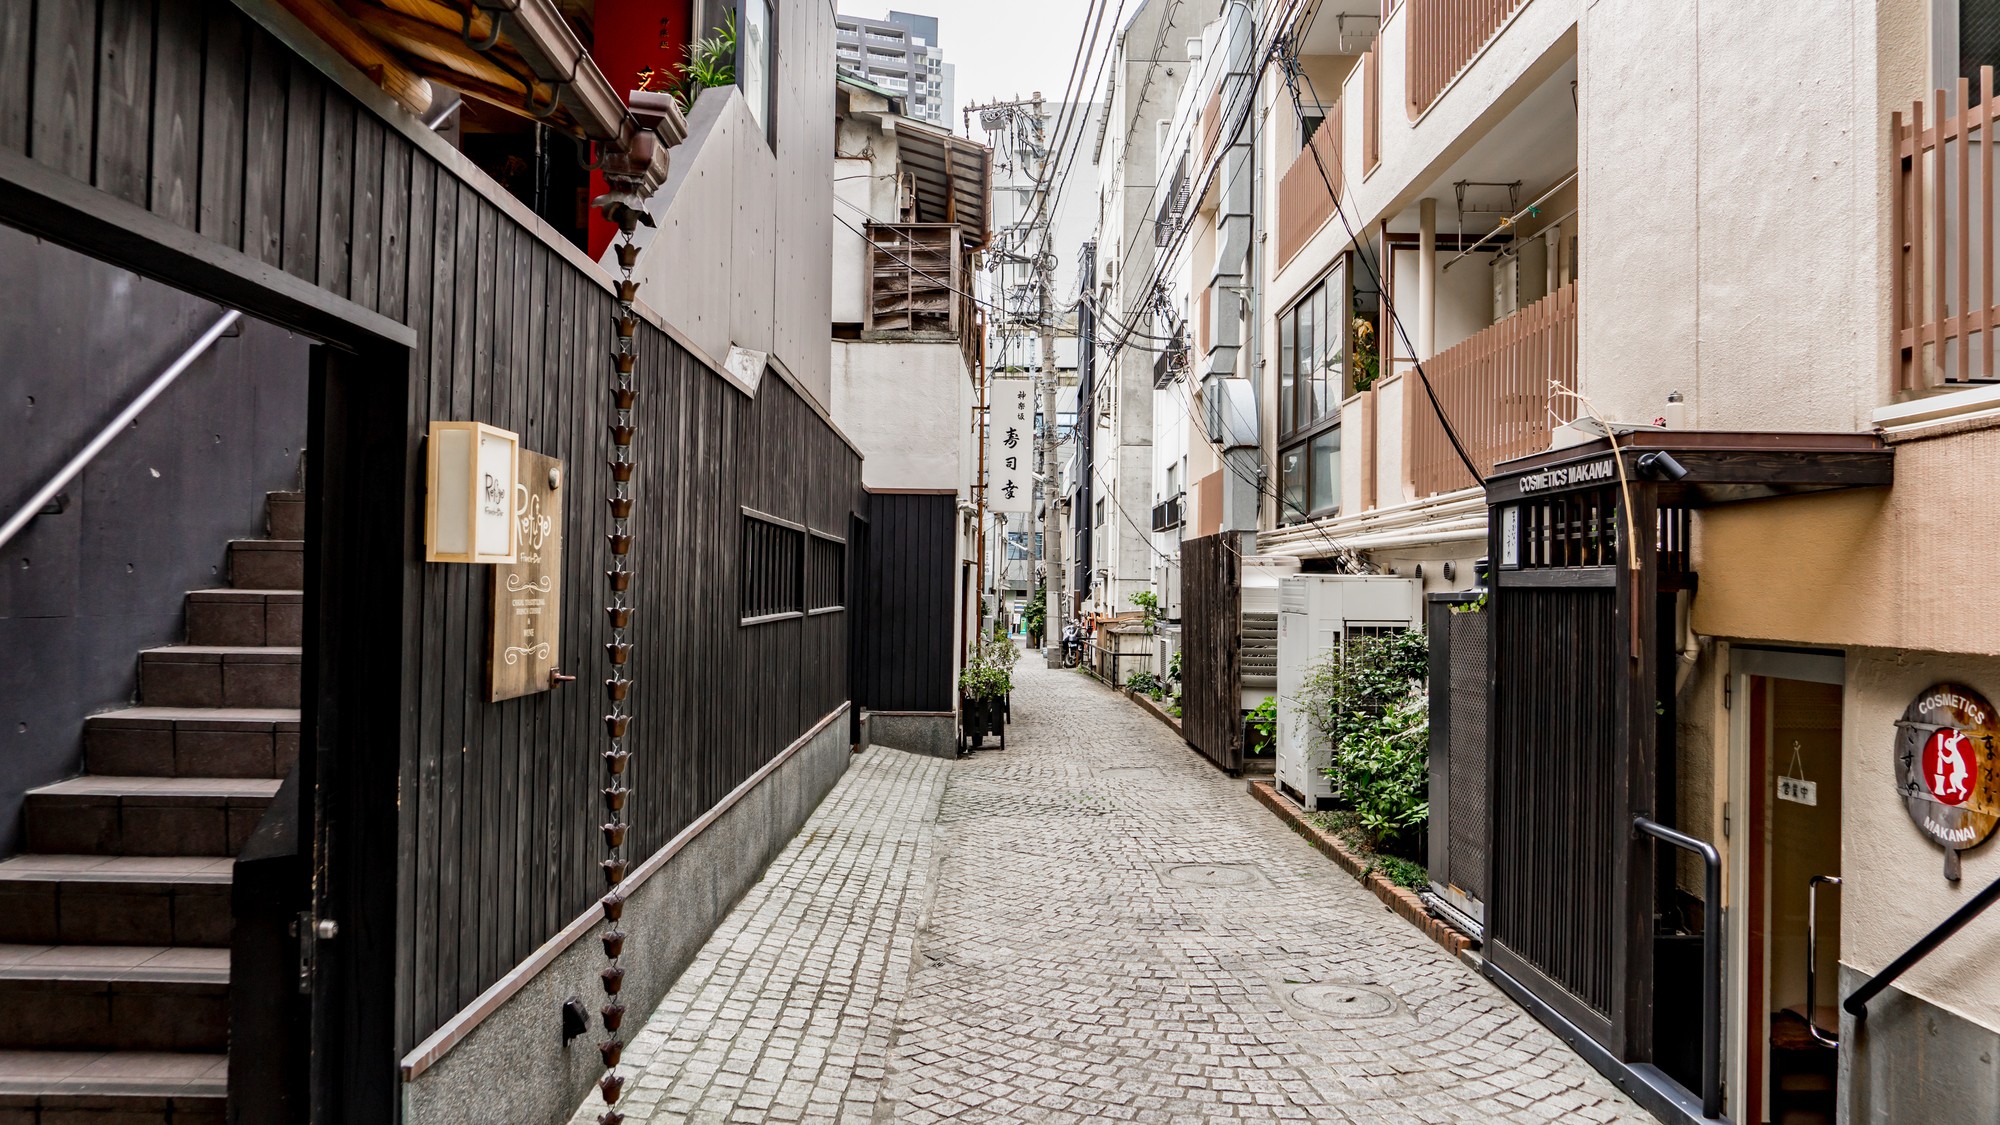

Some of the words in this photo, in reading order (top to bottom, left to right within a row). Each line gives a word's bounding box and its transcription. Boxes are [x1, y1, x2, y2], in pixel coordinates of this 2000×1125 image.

[1017, 390, 1027, 421] 神楽坂
[1519, 468, 1568, 493] COSMETICS
[1568, 459, 1613, 484] MAKANAI
[1918, 693, 1985, 725] COSMETICS
[1782, 781, 1809, 799] 営業中
[1923, 815, 1976, 843] MAKANAI
